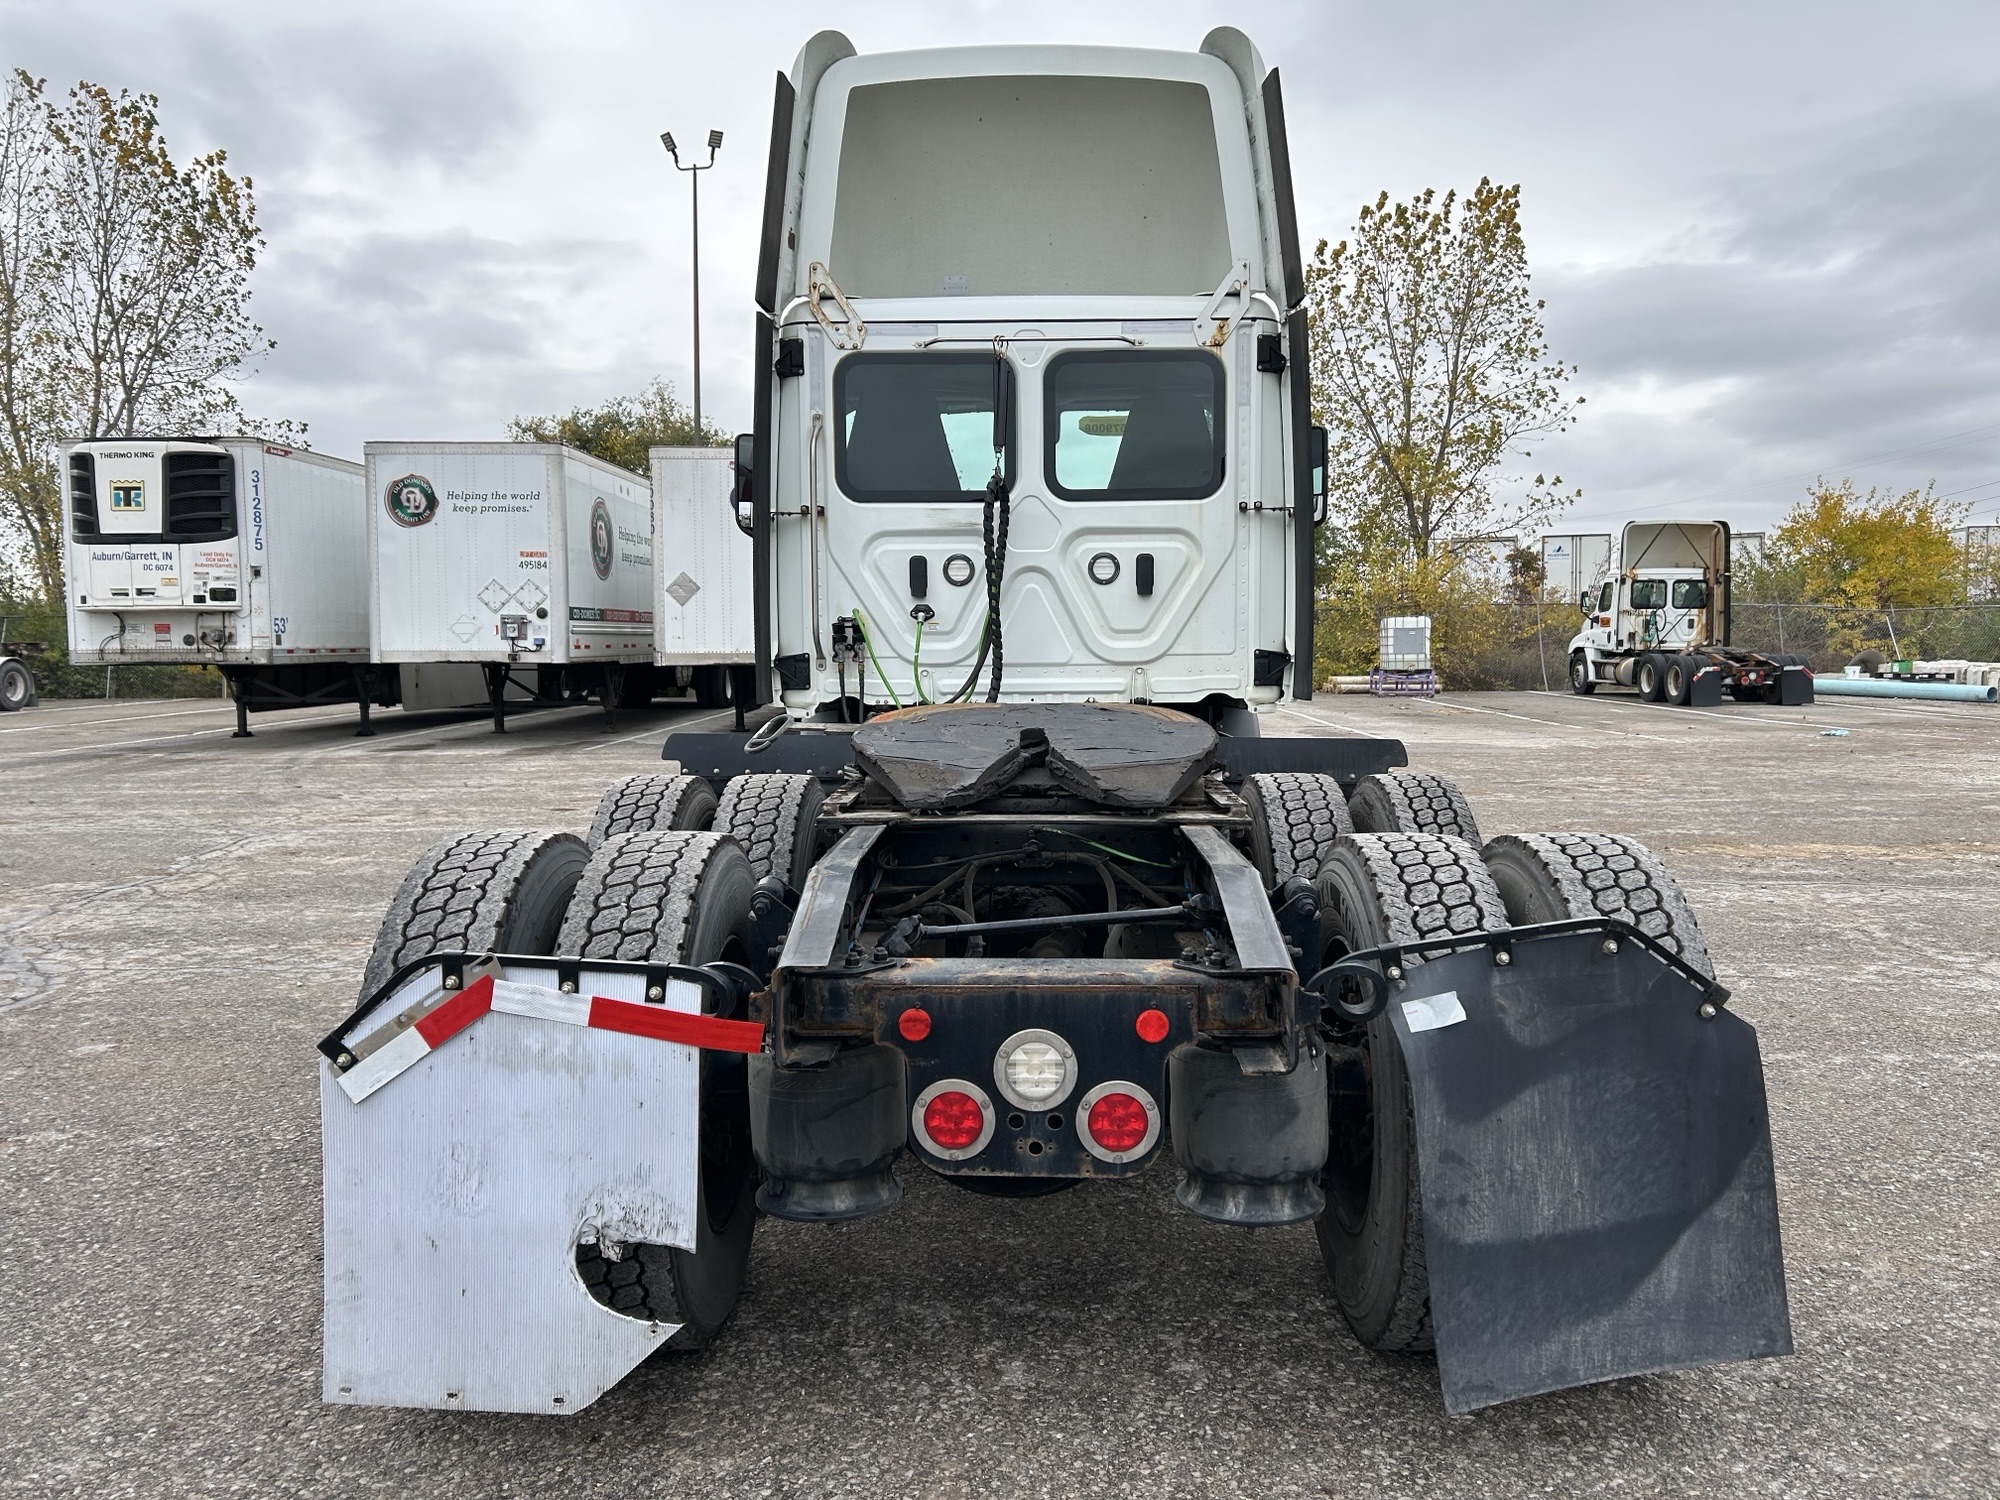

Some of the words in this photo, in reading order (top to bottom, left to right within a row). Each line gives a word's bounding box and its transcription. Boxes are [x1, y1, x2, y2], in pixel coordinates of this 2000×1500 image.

[99, 451, 132, 459] THERMO
[134, 451, 155, 459] KING
[393, 481, 404, 494] OLD
[404, 477, 432, 494] DOMINION
[446, 490, 488, 502] Helping
[491, 490, 507, 500] the
[510, 490, 541, 501] world
[251, 469, 263, 551] 312875
[452, 503, 478, 514] keep
[395, 508, 418, 522] FREIGHT
[618, 525, 636, 547] Helping
[92, 551, 160, 562] Auburn/Garrett,
[162, 551, 173, 561] IN
[518, 560, 548, 570] 495184
